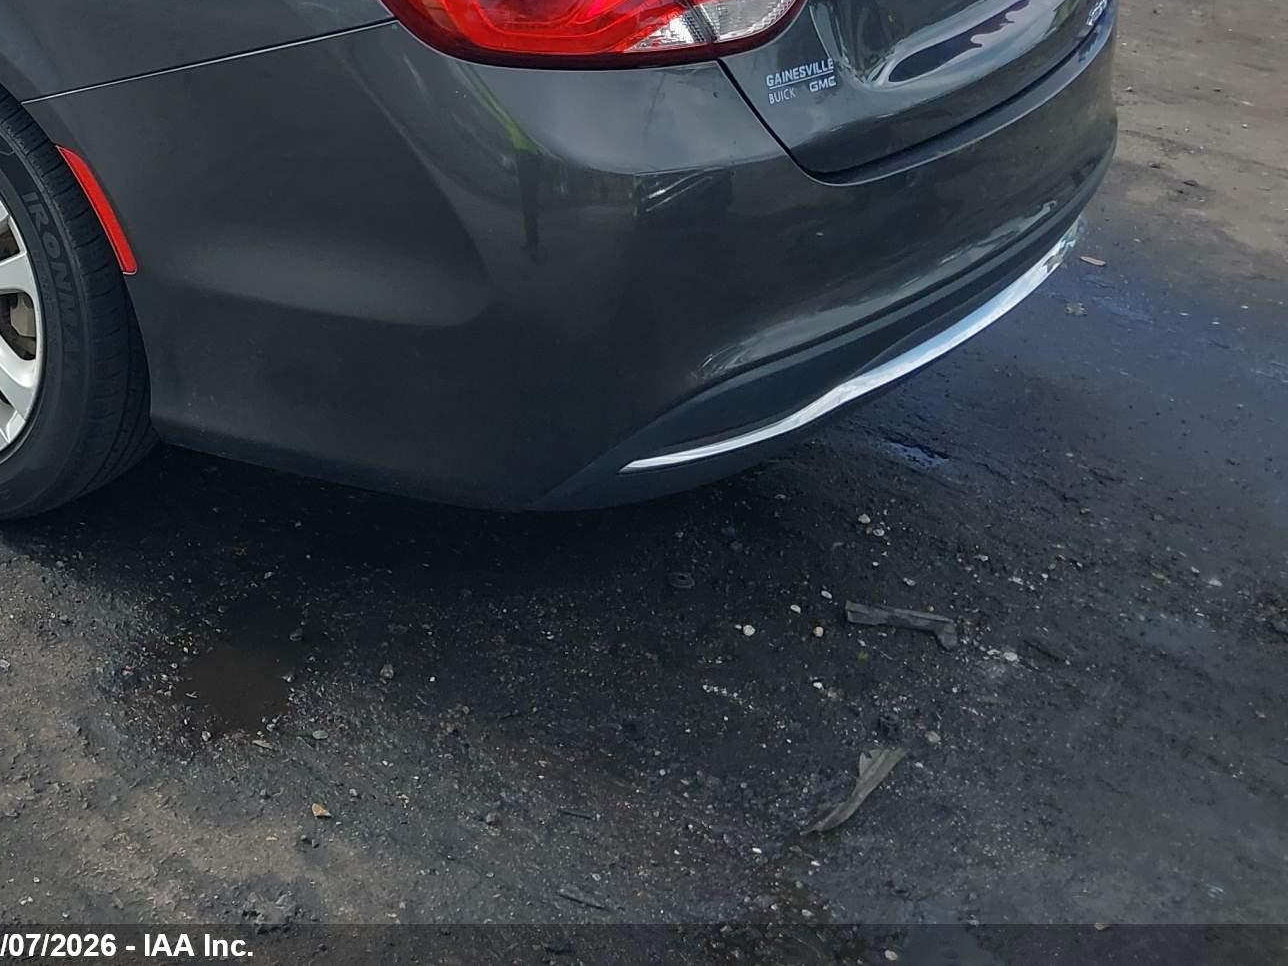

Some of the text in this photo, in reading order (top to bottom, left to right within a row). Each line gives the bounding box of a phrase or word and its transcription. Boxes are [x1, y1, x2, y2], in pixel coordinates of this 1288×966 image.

[766, 58, 834, 87] GAINESVILLE
[769, 76, 837, 104] BUICK GMC
